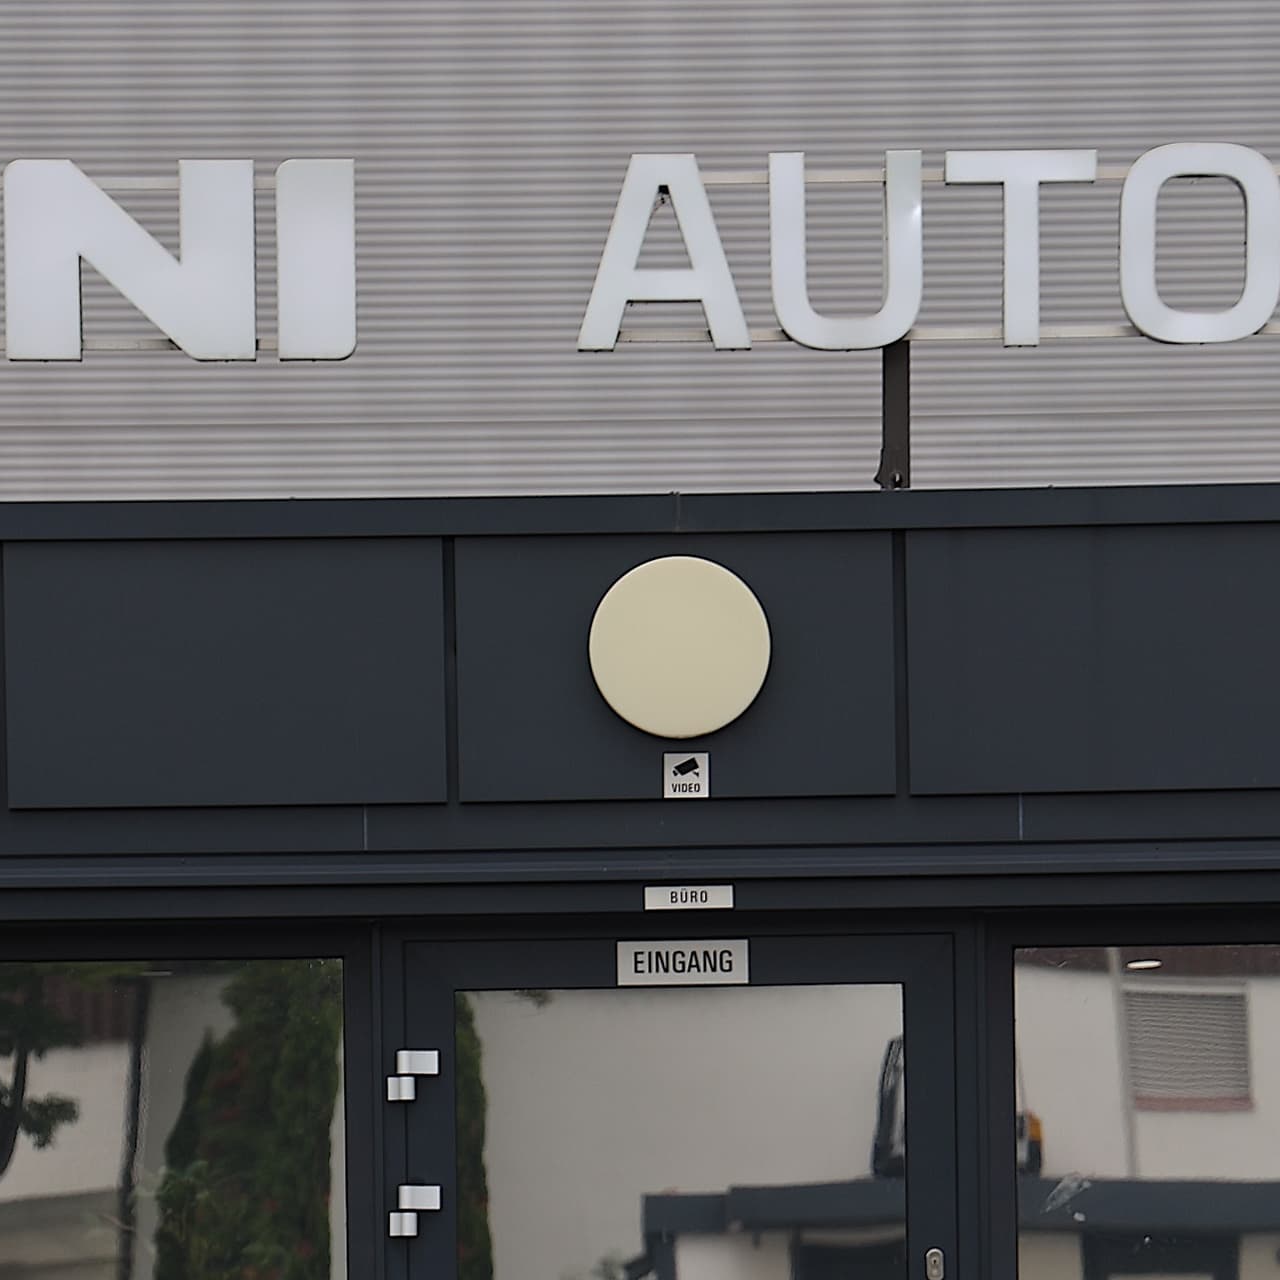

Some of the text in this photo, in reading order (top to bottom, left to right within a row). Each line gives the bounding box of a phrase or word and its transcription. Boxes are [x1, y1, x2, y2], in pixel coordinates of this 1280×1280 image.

[671, 782, 701, 793] VIDEO
[670, 887, 708, 904] BÜRO
[633, 949, 733, 974] EINGANG
